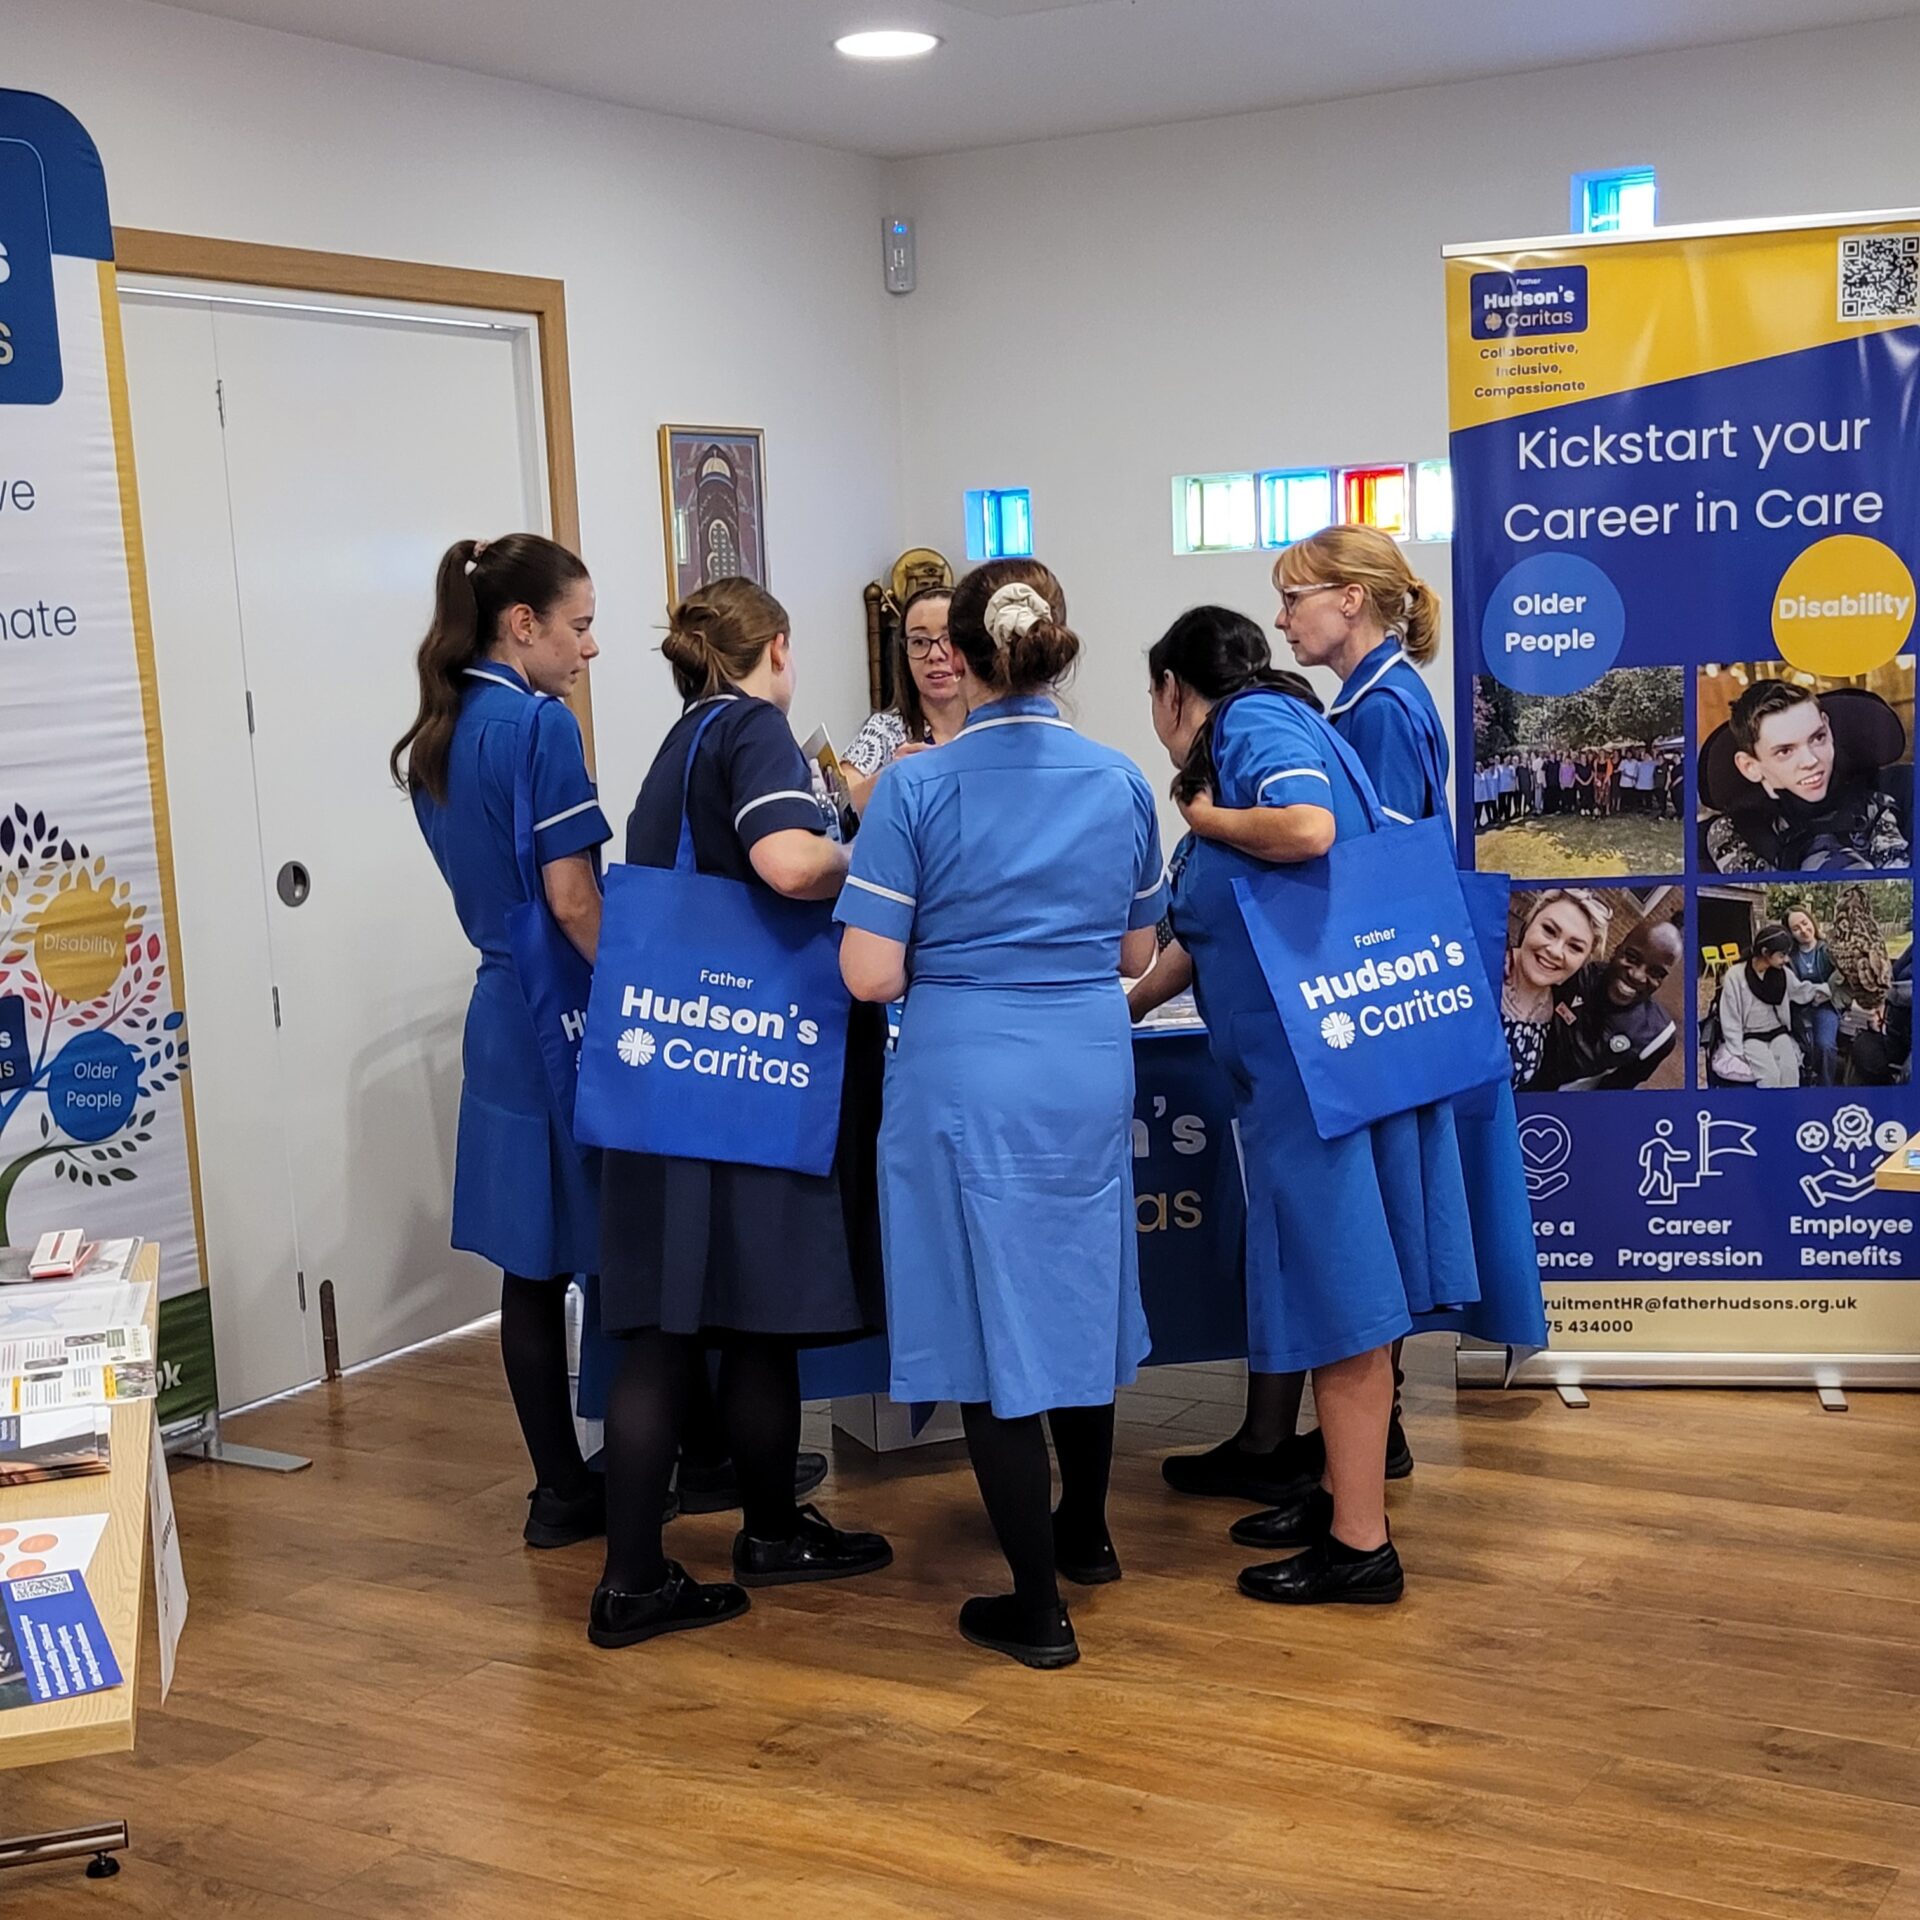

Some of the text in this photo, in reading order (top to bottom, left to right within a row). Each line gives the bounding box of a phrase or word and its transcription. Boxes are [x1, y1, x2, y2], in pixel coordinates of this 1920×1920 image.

[1483, 285, 1575, 309] Hudson's
[1505, 309, 1573, 328] Caritas
[1474, 381, 1586, 398] Compassionate
[1518, 417, 1871, 470] Kickstart your
[1503, 489, 1884, 542] Career in Care
[1513, 593, 1587, 616] Older
[1779, 591, 1911, 621] Disability
[1505, 628, 1596, 657] People
[43, 932, 118, 958] Disability
[1353, 928, 1396, 948] Father
[700, 969, 754, 990] Father
[1298, 934, 1465, 1010] Hudson's
[621, 985, 819, 1045] Hudson's
[1359, 984, 1474, 1037] Caritas
[74, 1062, 119, 1080] Older
[663, 1038, 810, 1088] Caritas
[66, 1090, 122, 1111] People
[1559, 1220, 1576, 1236] a
[1647, 1217, 1732, 1235] Career
[1790, 1215, 1913, 1240] Employee
[1617, 1246, 1763, 1272] Progression
[1800, 1246, 1903, 1266] Benefits
[1568, 1320, 1634, 1333] 434000
